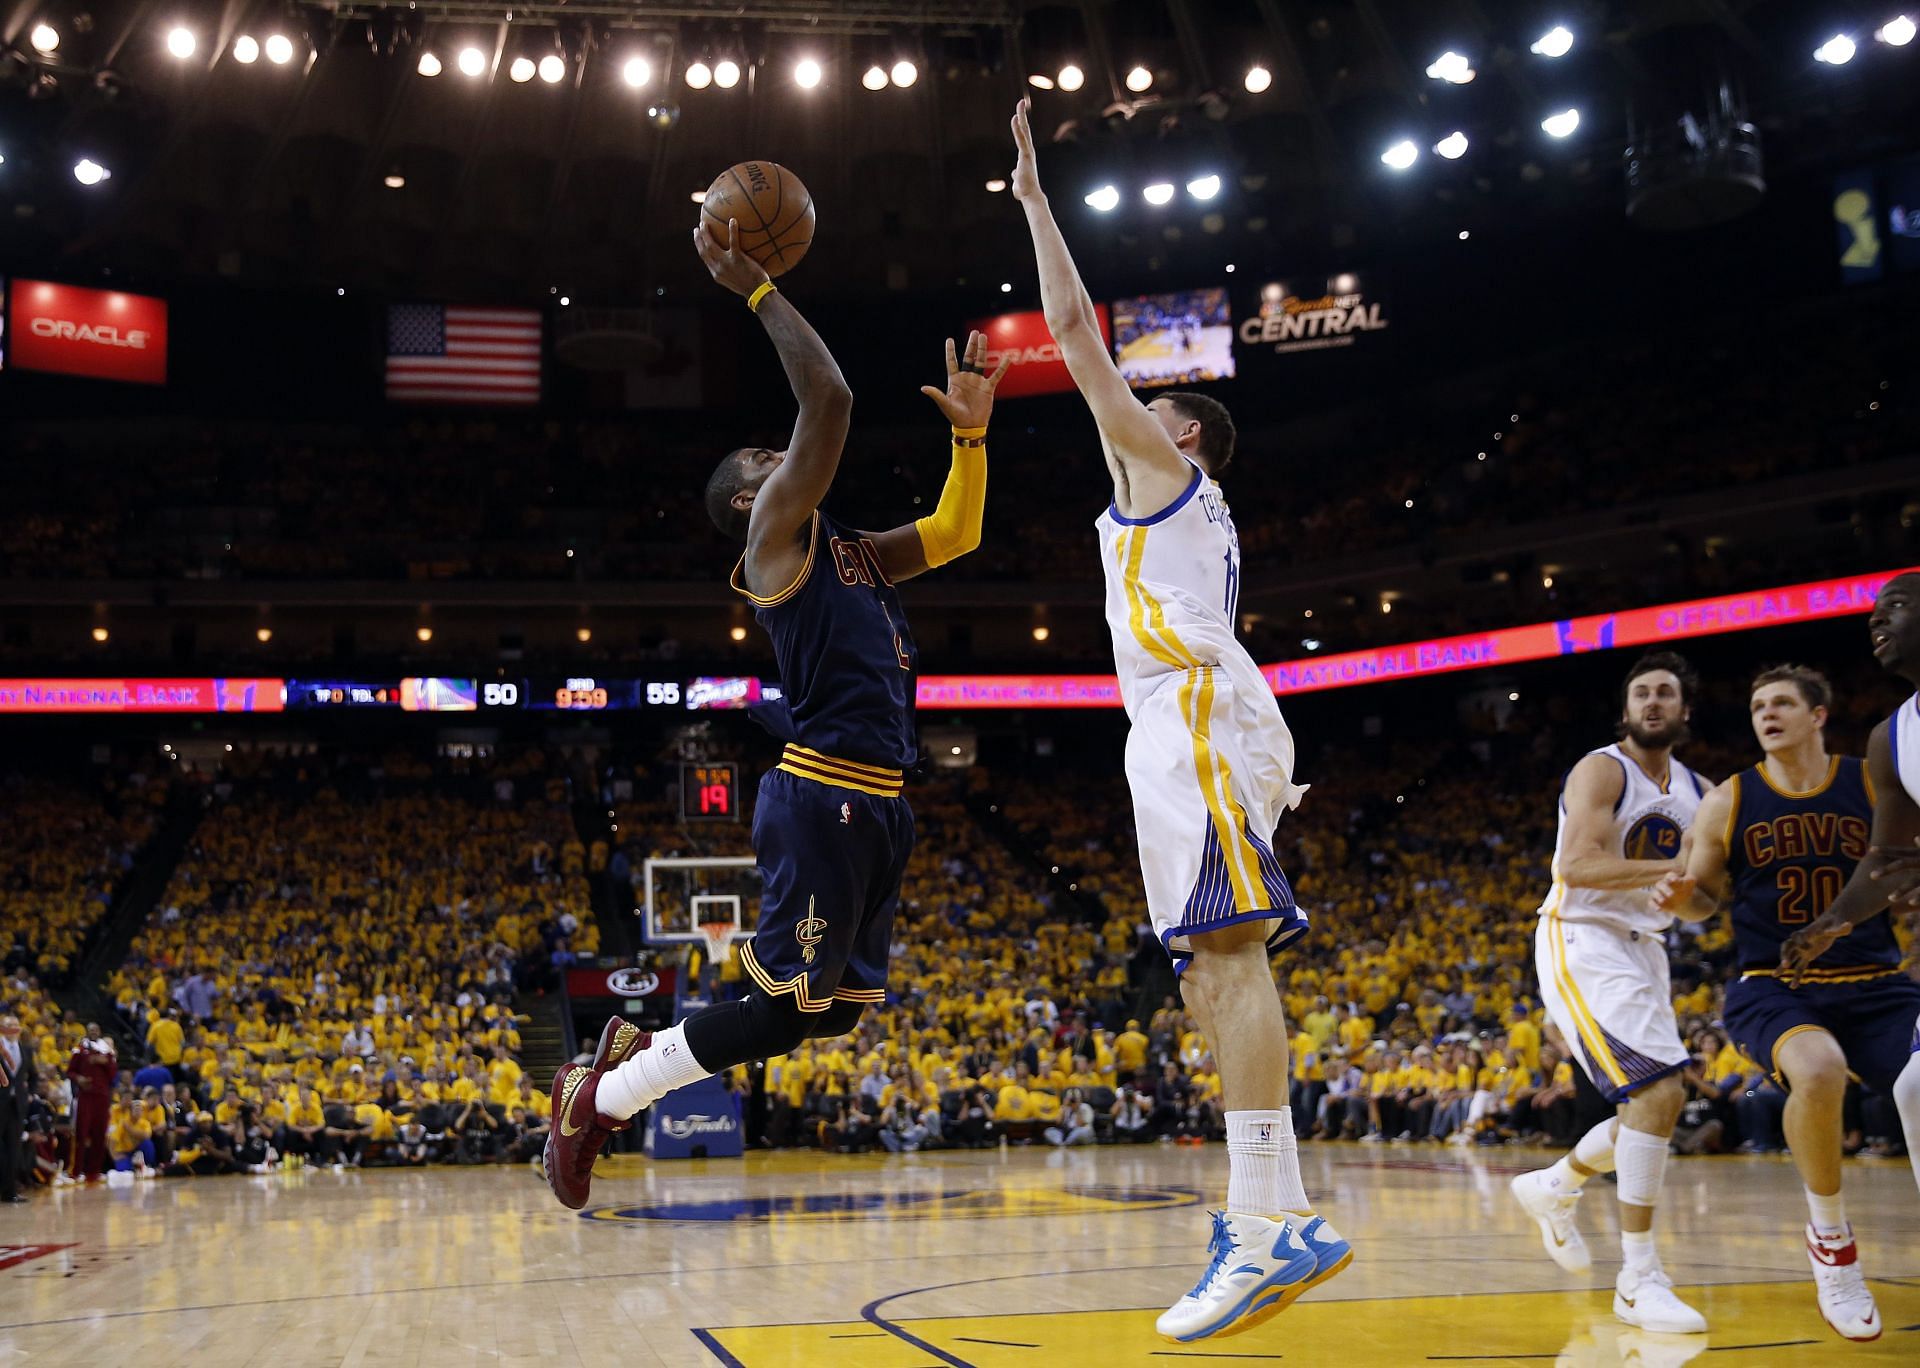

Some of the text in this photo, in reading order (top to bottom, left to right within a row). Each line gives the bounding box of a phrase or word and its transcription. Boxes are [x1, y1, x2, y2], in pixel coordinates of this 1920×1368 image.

[31, 317, 147, 349] ORACLE
[1239, 303, 1388, 344] CENTRAL
[1656, 594, 1802, 635] OFFICIAL
[1278, 653, 1415, 690] NATIONAL
[1416, 638, 1501, 671] BANK
[24, 684, 136, 705] NATIONAL
[137, 684, 201, 705] BANK
[484, 683, 518, 705] 50
[647, 682, 680, 705] 55
[961, 682, 1058, 701] NATIONAL
[1062, 680, 1116, 701] BANK
[700, 784, 728, 814] 19
[1656, 828, 1676, 848] 12
[1743, 812, 1870, 869] CAVS
[1776, 866, 1846, 926] 20
